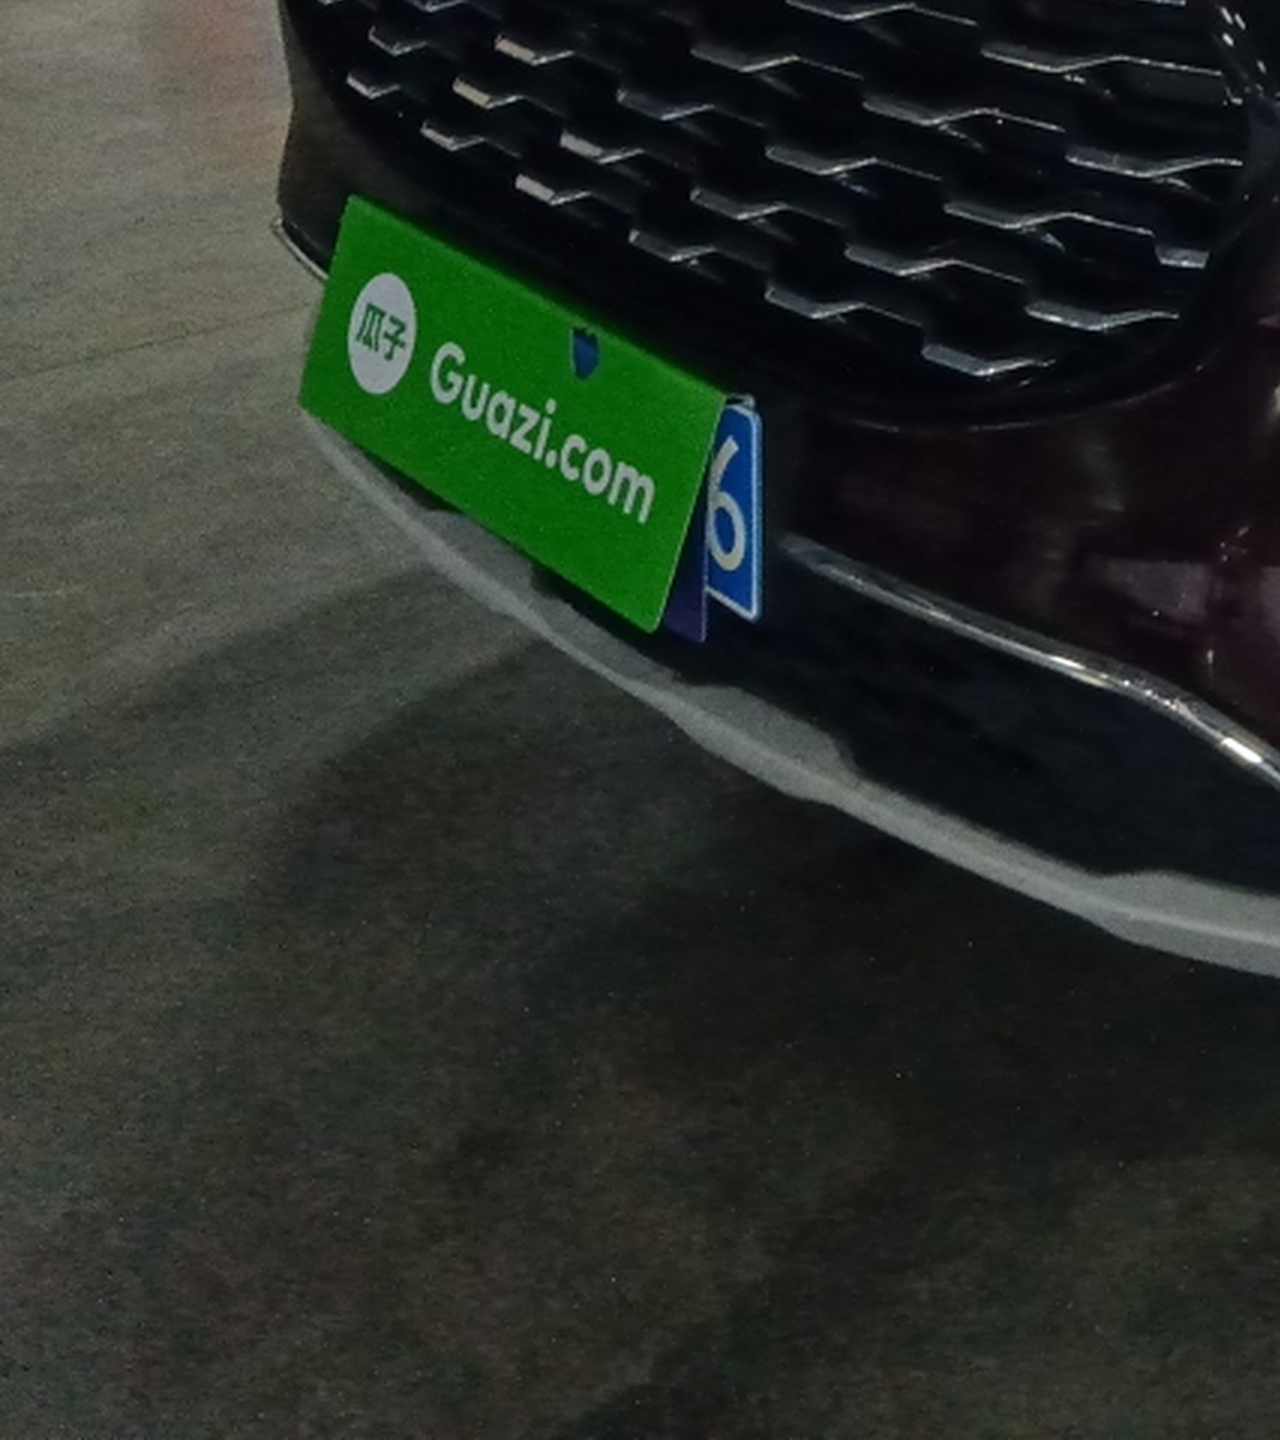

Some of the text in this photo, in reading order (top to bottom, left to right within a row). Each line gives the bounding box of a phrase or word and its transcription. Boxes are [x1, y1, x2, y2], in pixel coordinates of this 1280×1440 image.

[354, 302, 407, 361] 瓜子
[430, 342, 656, 524] Guazi.com
[707, 437, 746, 571] 6
